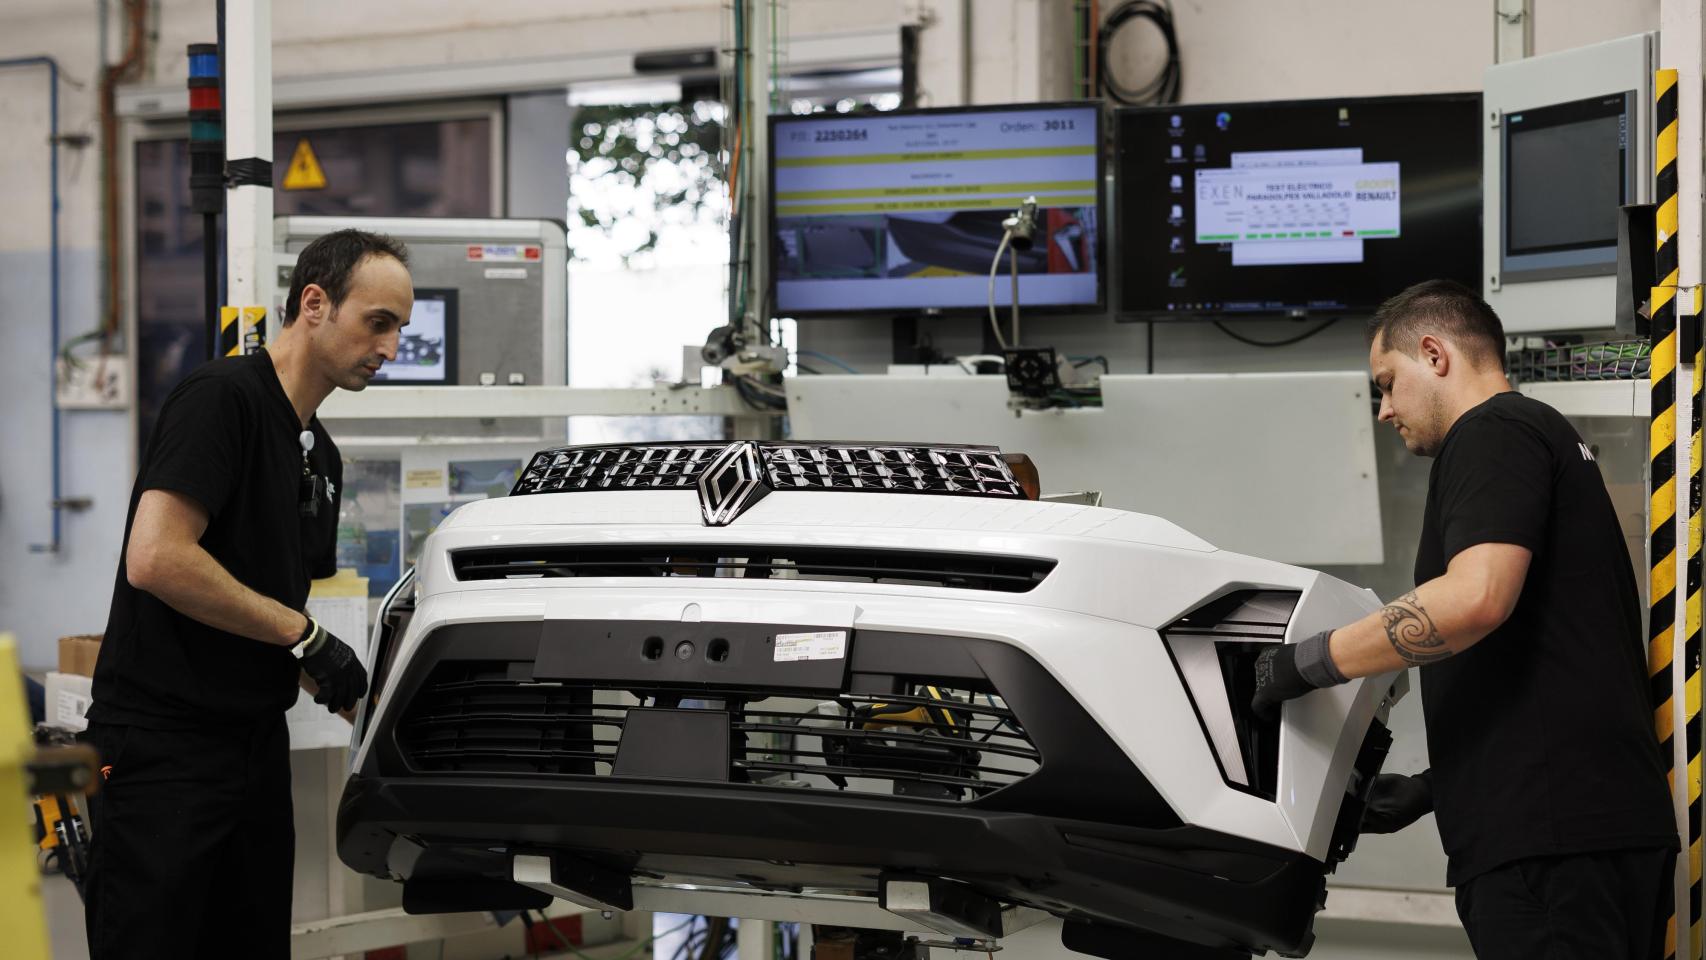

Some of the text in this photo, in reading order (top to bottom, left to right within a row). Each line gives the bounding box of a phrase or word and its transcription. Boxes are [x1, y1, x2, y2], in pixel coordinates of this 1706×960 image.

[1000, 119, 1075, 134] Orden: 3011
[1199, 184, 1244, 200] EXEN
[1356, 191, 1397, 201] RENAULT
